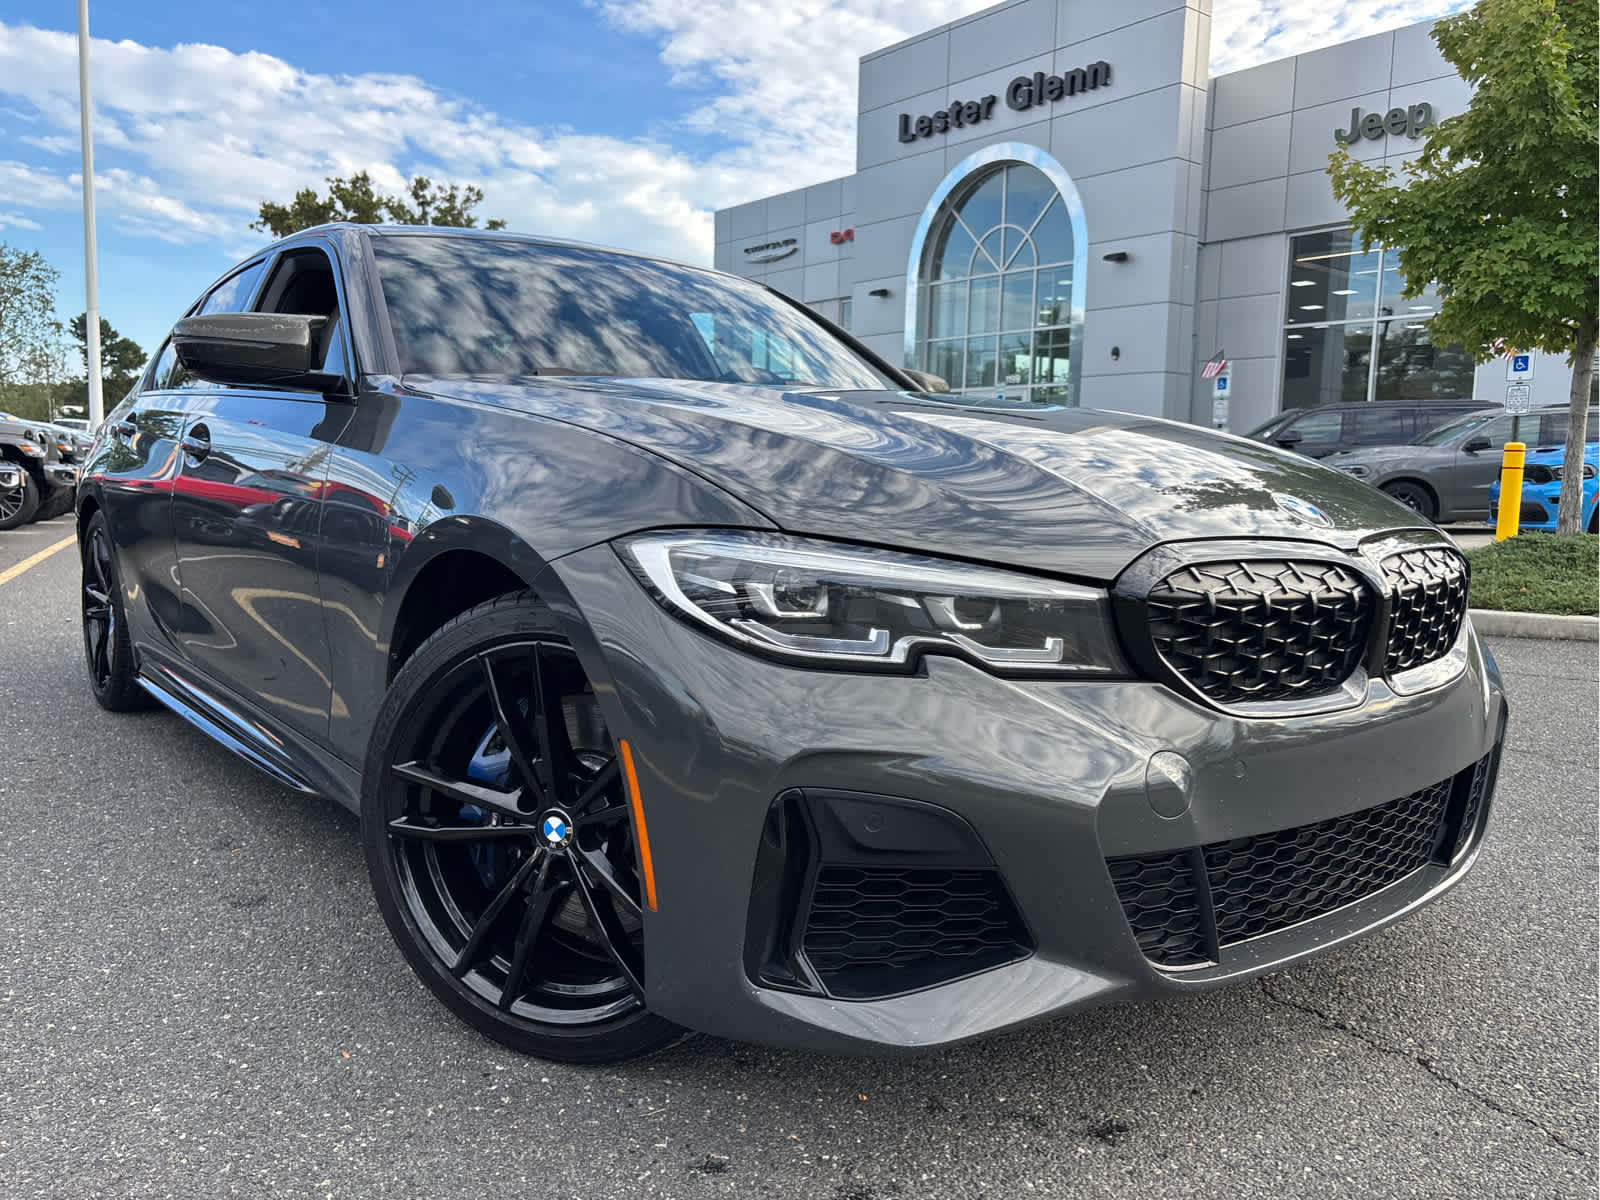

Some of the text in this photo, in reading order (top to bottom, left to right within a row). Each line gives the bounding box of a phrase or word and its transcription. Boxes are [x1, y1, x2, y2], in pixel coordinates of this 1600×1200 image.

[898, 60, 1111, 143] Lester Glenn
[1334, 102, 1433, 145] Jeep
